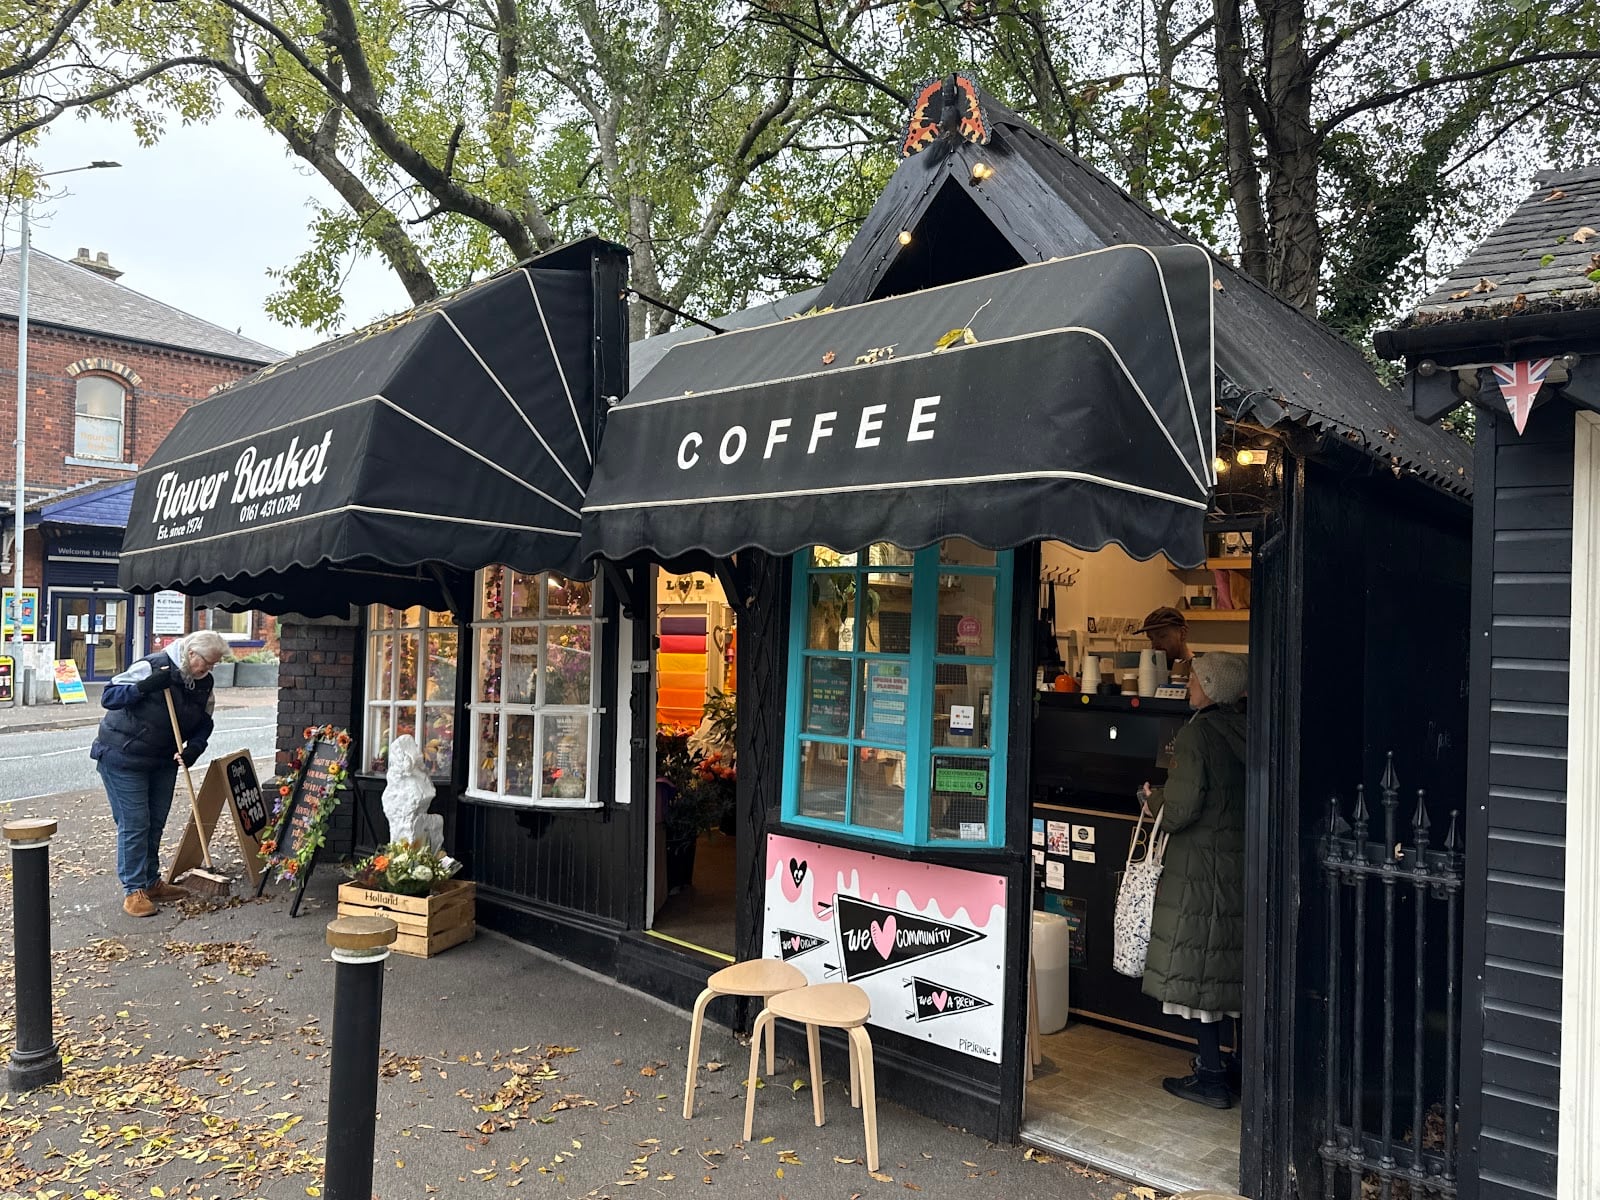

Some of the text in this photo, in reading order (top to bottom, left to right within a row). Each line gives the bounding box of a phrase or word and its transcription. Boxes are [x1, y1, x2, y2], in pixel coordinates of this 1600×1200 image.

[676, 395, 941, 470] COFFEE
[152, 428, 333, 523] Flower Basket
[239, 493, 302, 522] 0161 431 0784
[169, 522, 185, 540] since
[186, 516, 204, 536] 1974
[58, 547, 90, 556] Welcome
[365, 891, 398, 905] Holland
[896, 927, 951, 949] COMMUNITY
[947, 995, 953, 1009] A
[954, 996, 975, 1010] BREW
